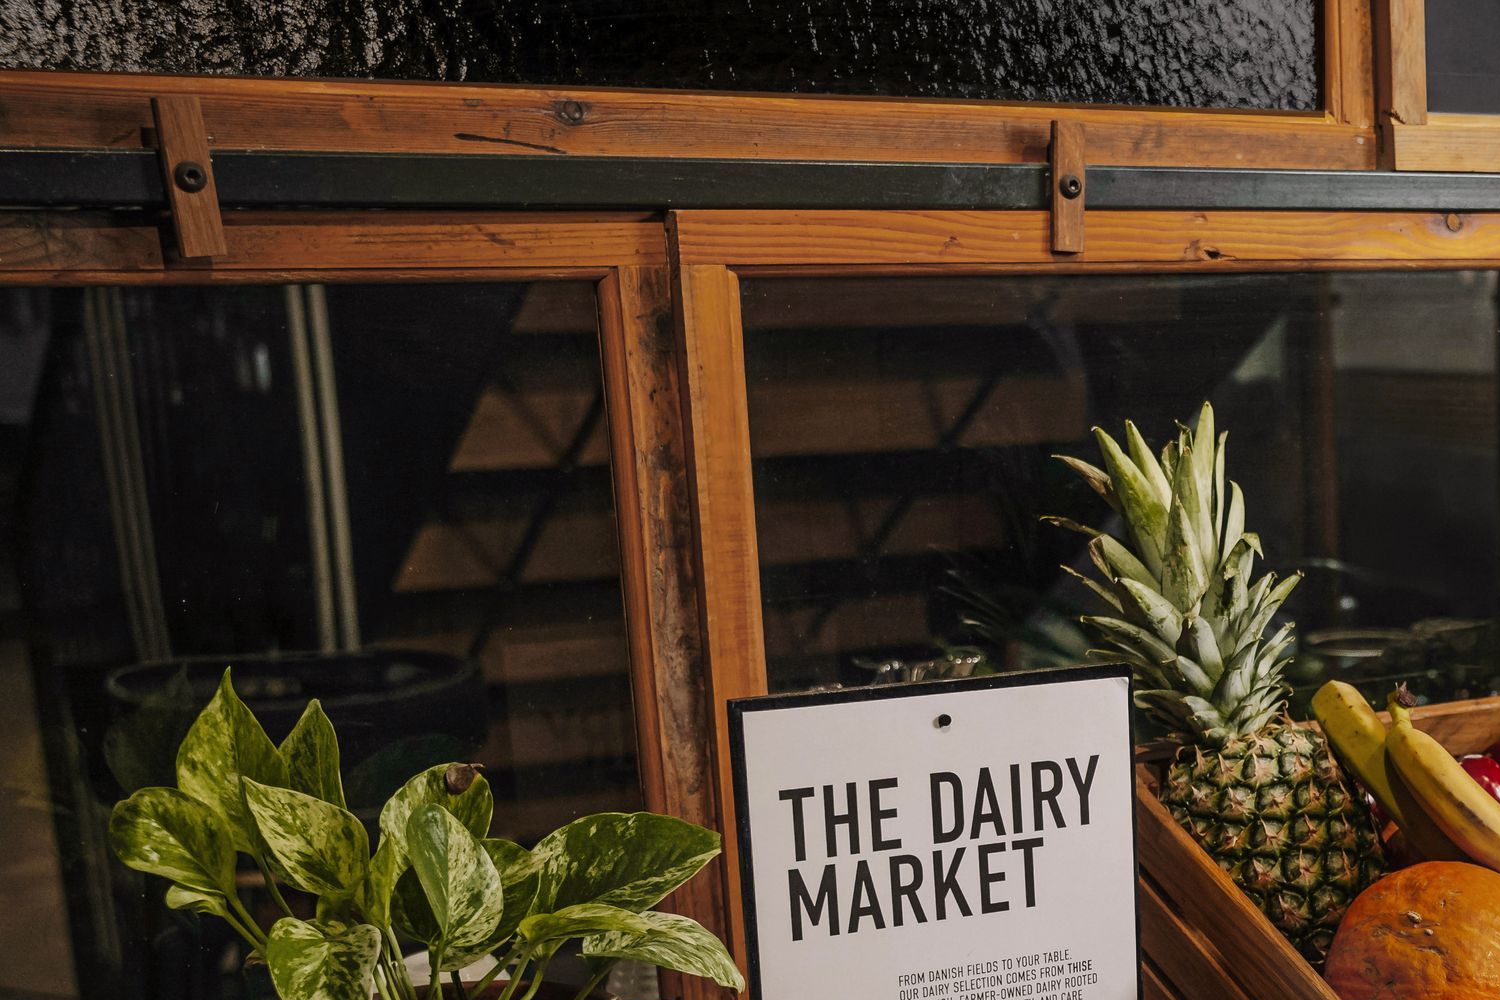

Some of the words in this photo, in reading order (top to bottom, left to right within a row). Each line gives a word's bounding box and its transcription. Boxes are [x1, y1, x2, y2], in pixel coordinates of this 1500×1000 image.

[779, 777, 901, 861] THE
[930, 755, 1099, 844] DAIRY
[788, 837, 1043, 941] MARKET
[899, 972, 925, 987] FROM
[929, 966, 963, 982] DANISH
[967, 961, 998, 976] FIELDS
[1002, 958, 1012, 970] TO
[1016, 954, 1040, 968] YOUR
[1043, 949, 1072, 963] TABLE.
[900, 988, 919, 1000] OUR
[923, 983, 949, 998] DAIRY
[954, 975, 1002, 993] SELECTION
[1006, 969, 1036, 984] COMES
[1040, 964, 1064, 978] FROM
[1067, 960, 1092, 974] THISE
[1036, 979, 1061, 994] DAIRY
[1065, 973, 1097, 988] ROOTED
